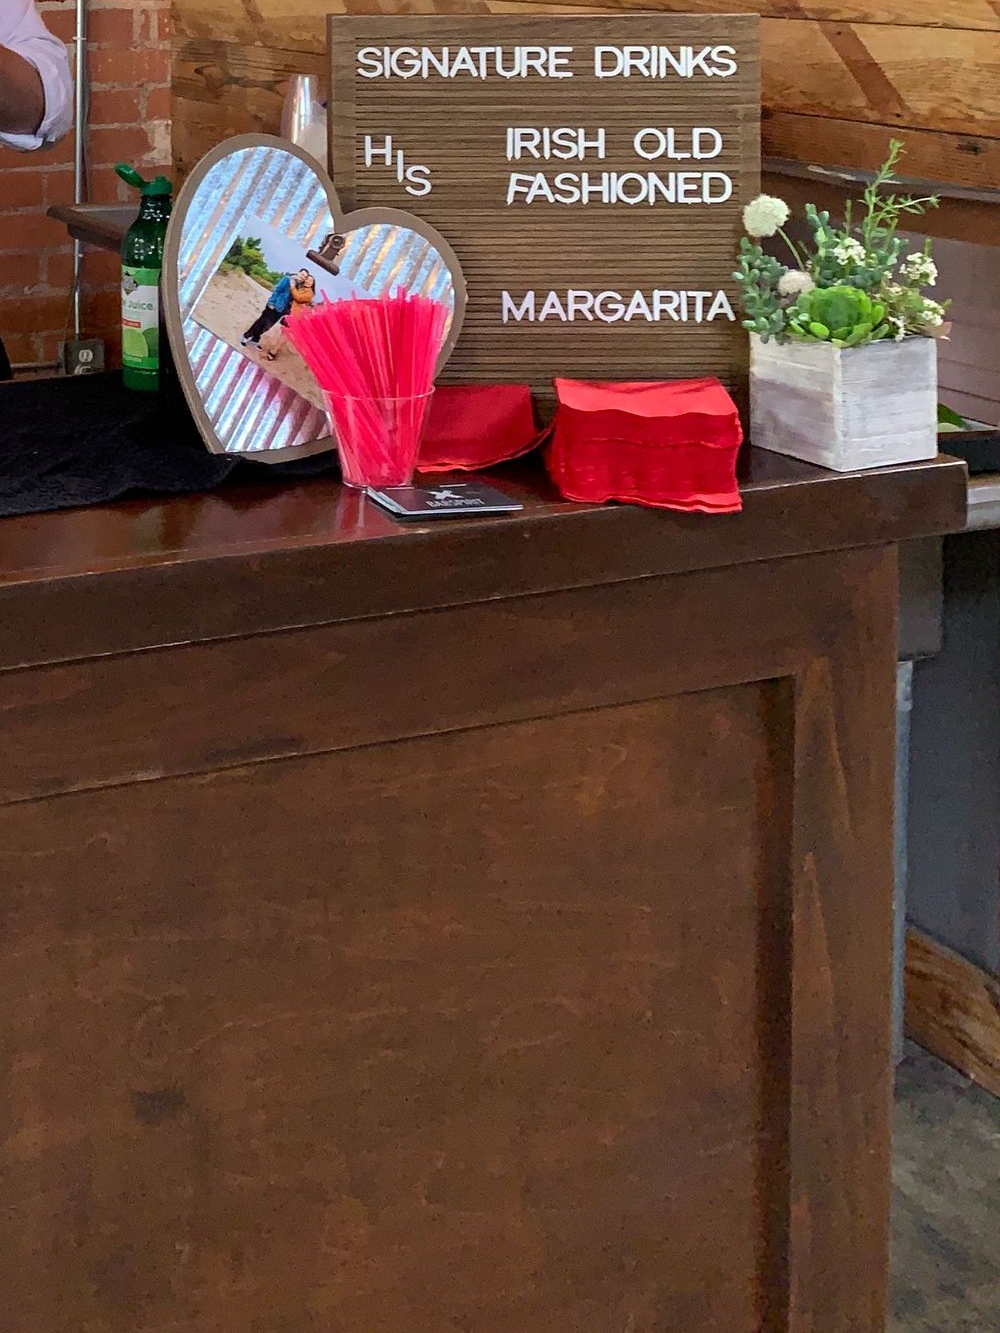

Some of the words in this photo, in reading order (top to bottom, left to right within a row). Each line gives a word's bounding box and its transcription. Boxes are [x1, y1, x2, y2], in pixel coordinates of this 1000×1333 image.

[356, 46, 574, 79] SIGNATURE
[595, 45, 738, 78] DRINKS
[506, 127, 605, 161] IRISH
[633, 127, 723, 160] OLD
[363, 135, 432, 197] HIS
[506, 171, 734, 205] FASHIONED
[502, 289, 737, 324] MARGARITA
